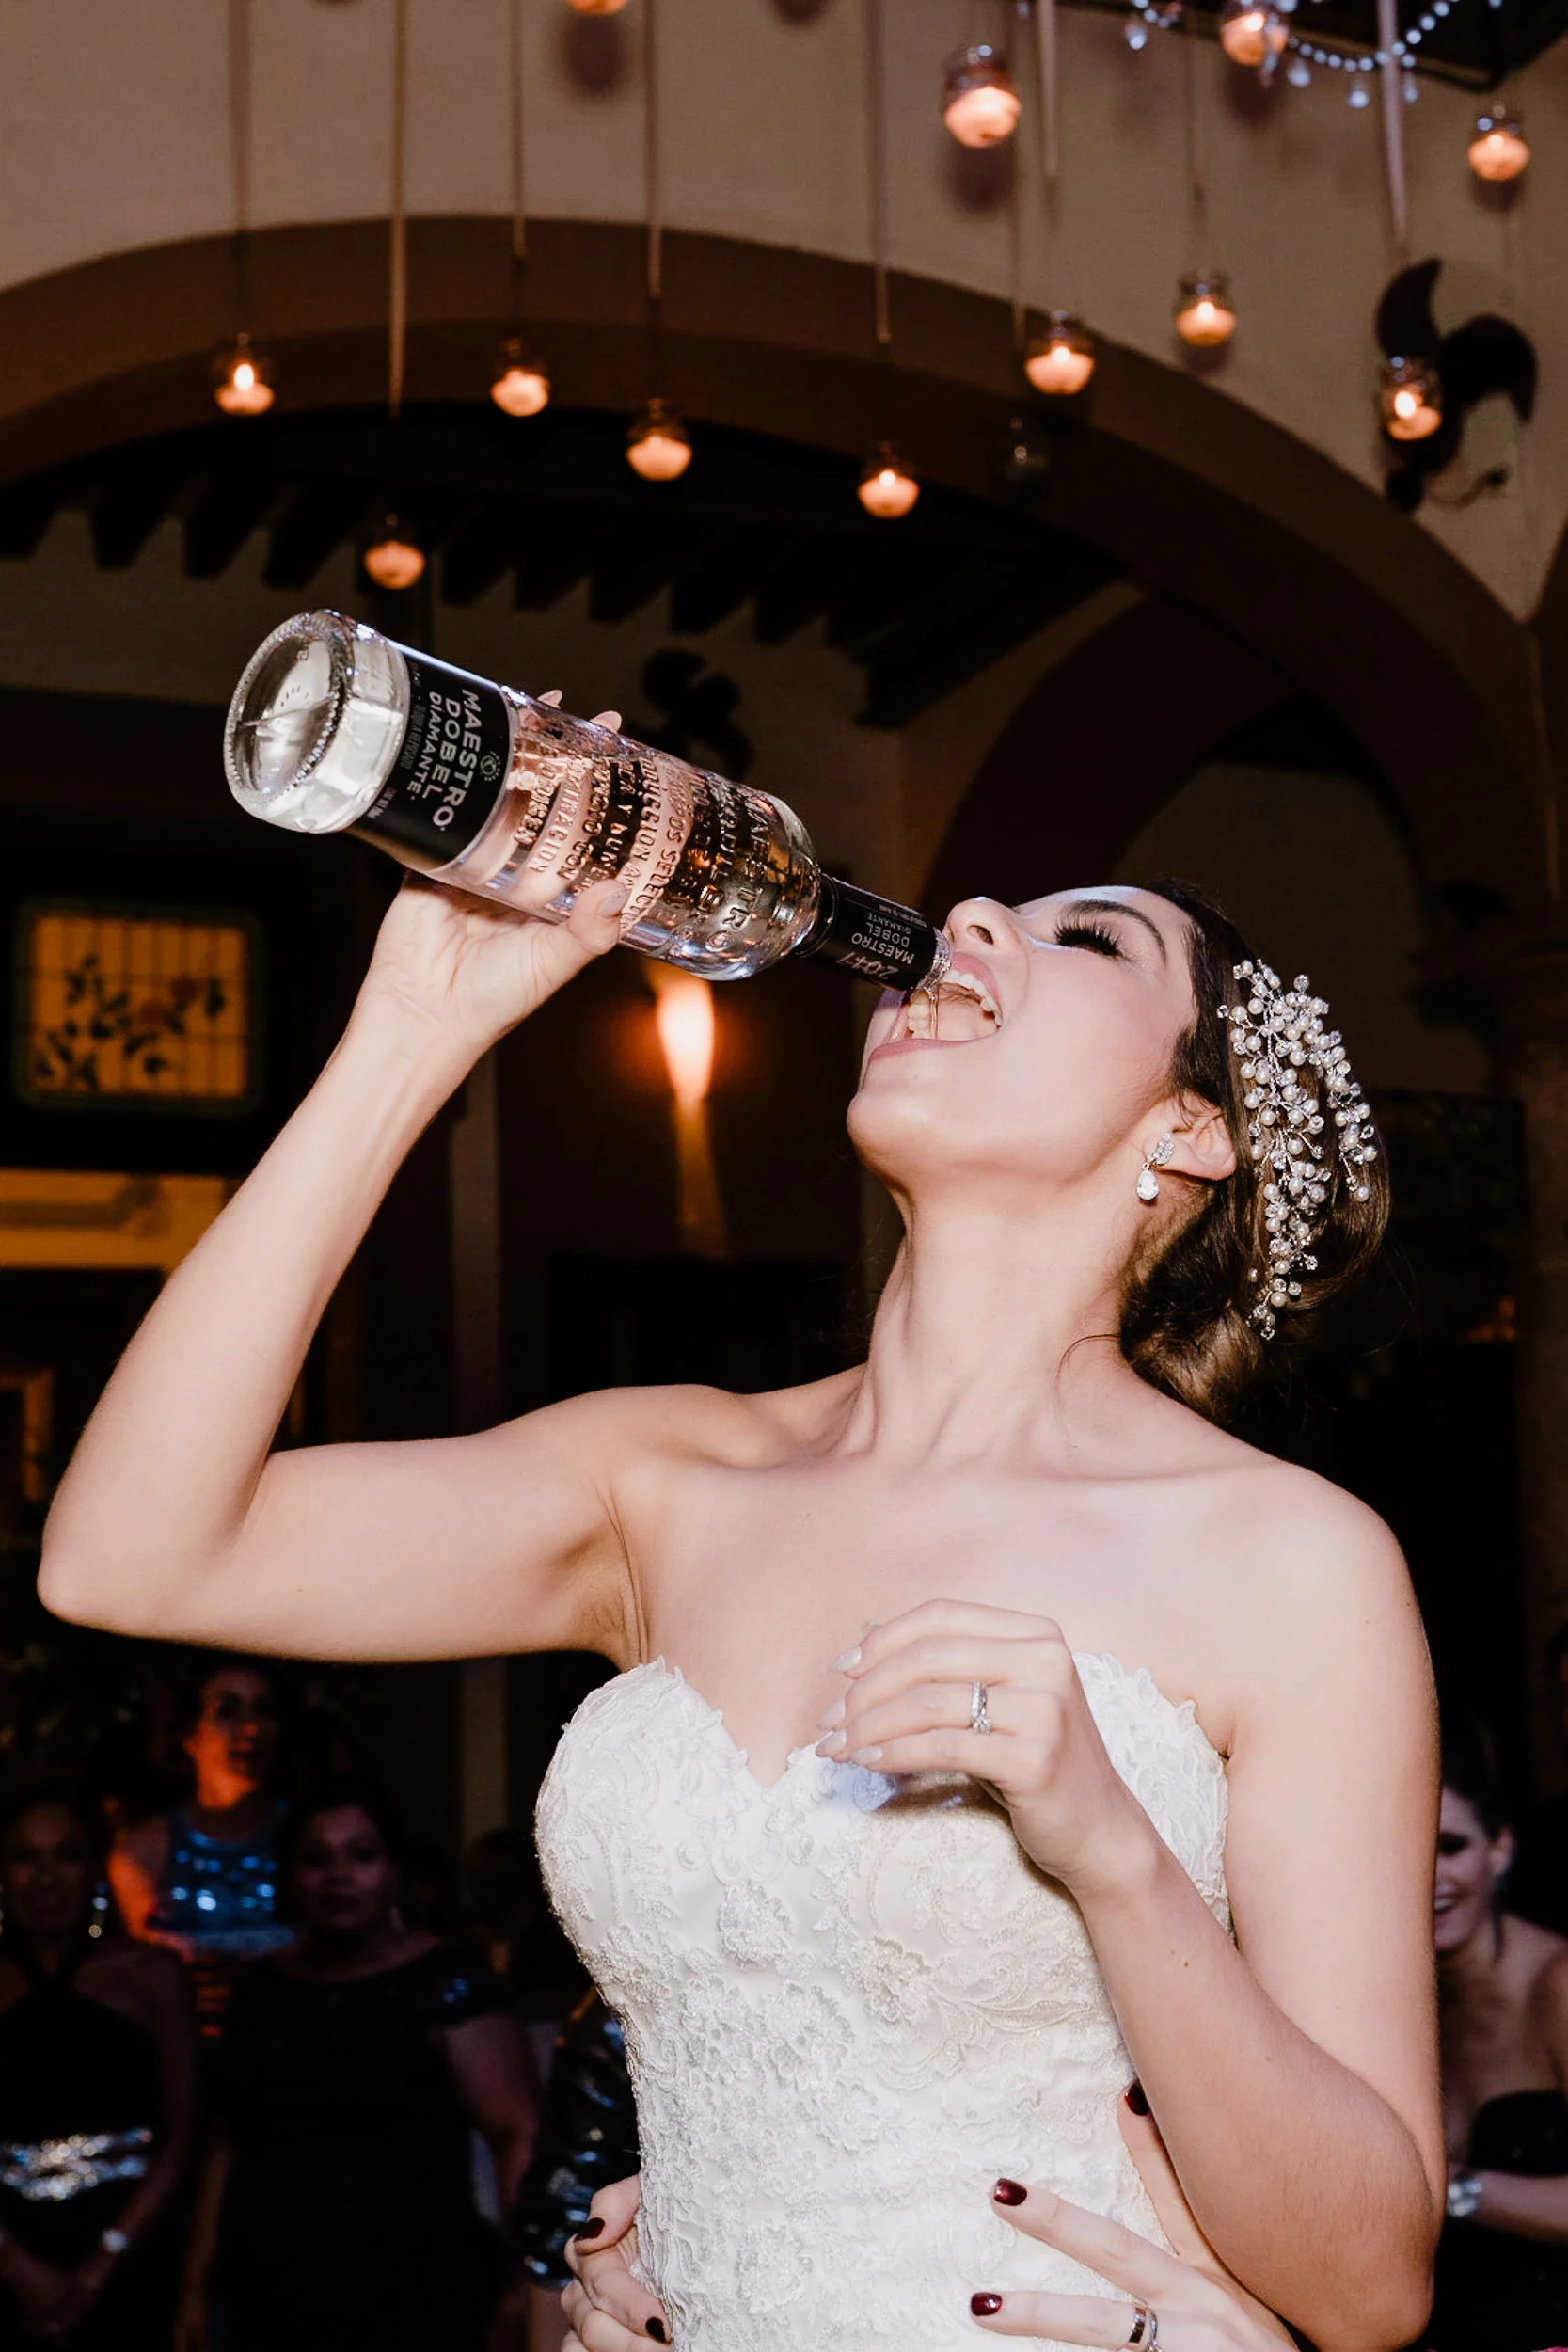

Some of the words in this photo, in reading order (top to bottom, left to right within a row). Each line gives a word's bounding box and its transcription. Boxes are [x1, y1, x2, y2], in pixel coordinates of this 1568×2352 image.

[407, 691, 442, 791] DIAMANTE
[421, 698, 460, 798] DOBEL
[432, 689, 481, 828] MAESTRO
[849, 931, 915, 965] MAESTRO
[863, 921, 911, 947] DOBEL
